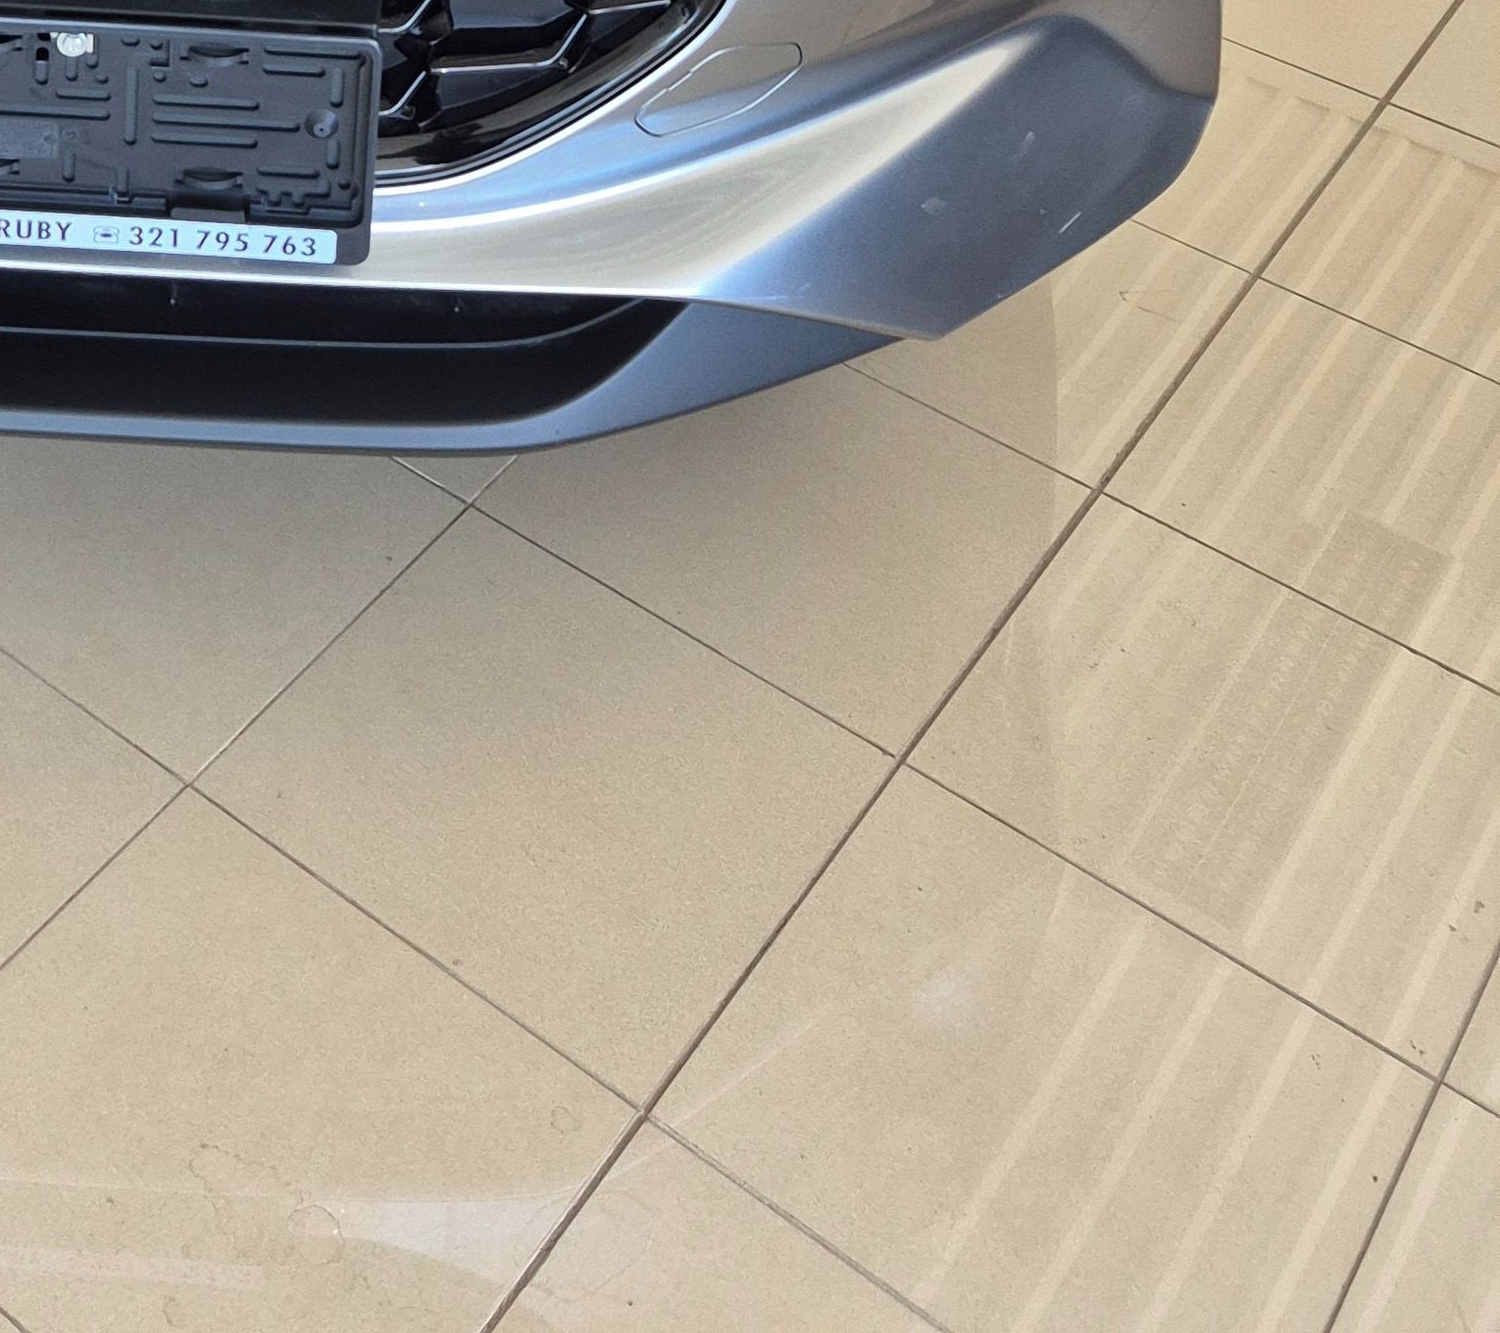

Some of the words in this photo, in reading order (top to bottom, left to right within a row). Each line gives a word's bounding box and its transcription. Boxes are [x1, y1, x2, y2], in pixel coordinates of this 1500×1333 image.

[128, 227, 179, 248] 321
[195, 230, 249, 252] 795
[263, 234, 316, 257] 763
